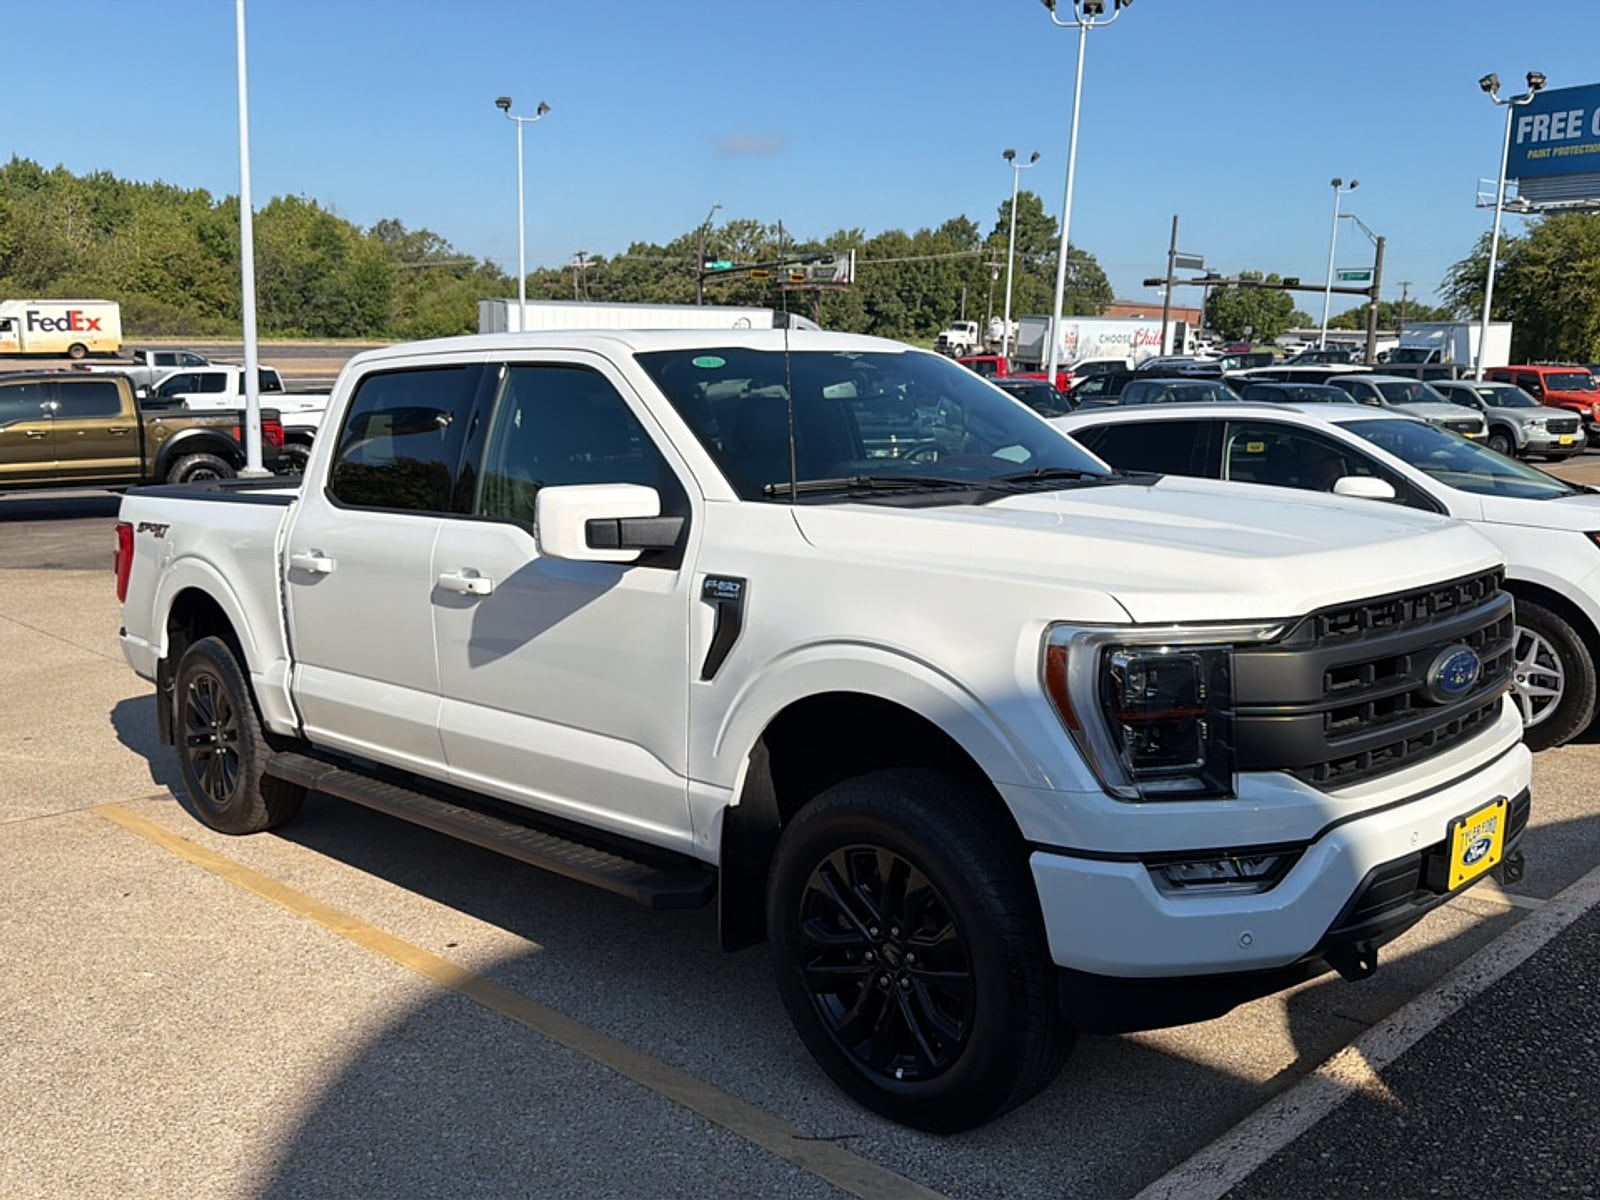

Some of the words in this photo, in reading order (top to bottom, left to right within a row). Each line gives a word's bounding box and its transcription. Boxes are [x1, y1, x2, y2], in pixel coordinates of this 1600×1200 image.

[1516, 109, 1584, 145] FREE
[1527, 148, 1551, 160] PAINT
[26, 310, 102, 332] FedEx
[1099, 333, 1131, 345] CHOOSE
[1460, 823, 1481, 851] TYLER
[1482, 814, 1498, 836] FORD
